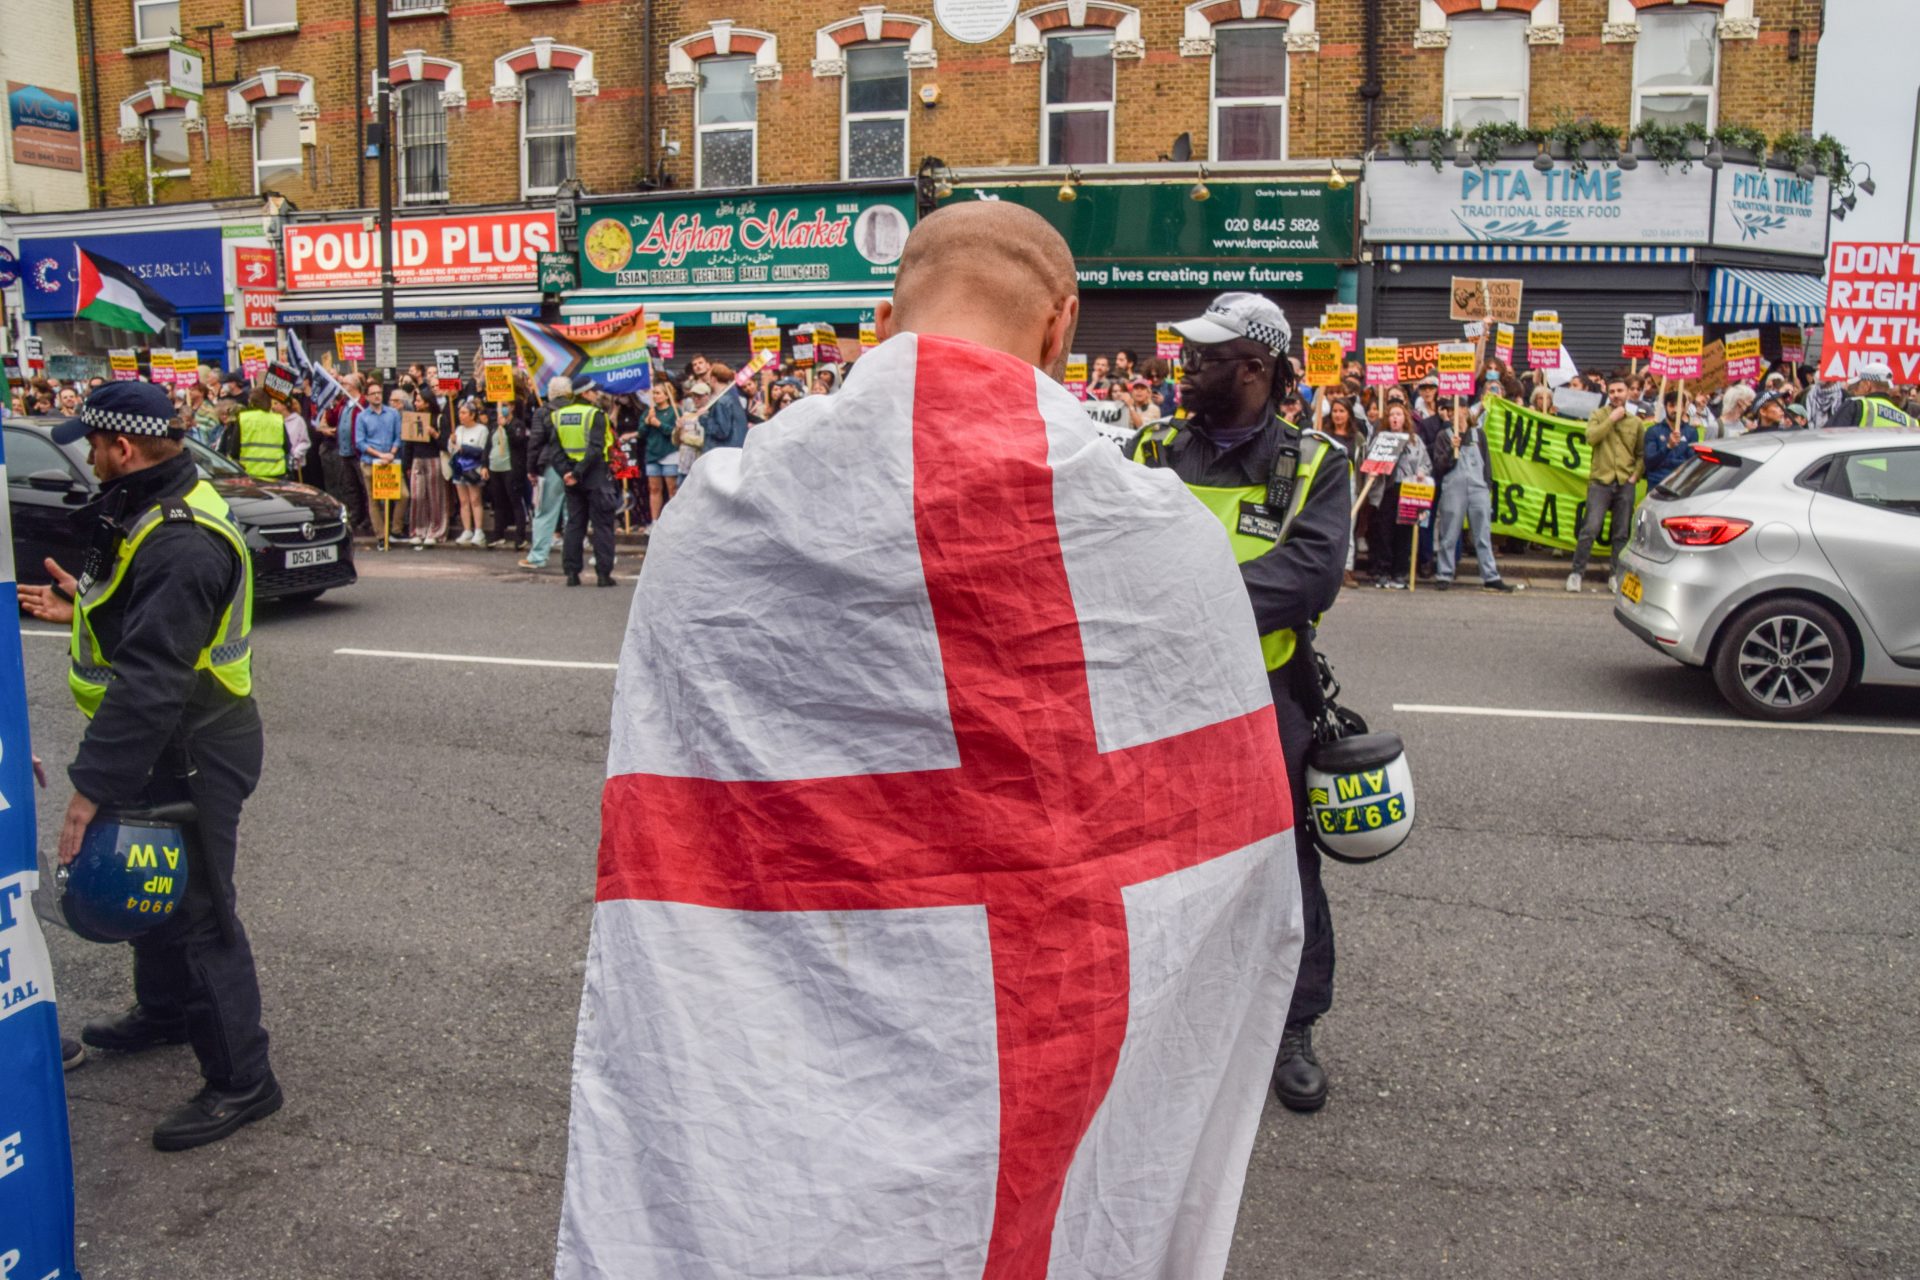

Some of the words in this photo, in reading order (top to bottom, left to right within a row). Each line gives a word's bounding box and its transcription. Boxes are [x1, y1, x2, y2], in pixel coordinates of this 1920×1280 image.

[1461, 169, 1531, 200] PITA
[1542, 169, 1622, 201] TIME
[1734, 172, 1770, 200] PITA
[1774, 178, 1813, 206] TIME
[1461, 205, 1541, 217] TRADITIONAL
[1545, 205, 1584, 217] GREEK
[1588, 205, 1621, 217] FOOD
[1733, 200, 1772, 213] TRADITIONAL
[1775, 205, 1794, 216] GREEK
[1795, 208, 1812, 218] FOOD
[1225, 219, 1249, 231] 020
[1253, 219, 1286, 231] 8445
[1289, 219, 1320, 231] 5826
[291, 229, 428, 271] POUND
[441, 222, 551, 265] PLUS
[636, 212, 733, 267] Afghan
[739, 207, 852, 250] Market
[1213, 235, 1319, 251] www.terapia.co.uk
[617, 270, 648, 285] ASIAN
[650, 269, 688, 284] GROCERIES
[692, 268, 735, 283] VEGETABLES
[739, 266, 768, 281] BAKERY
[802, 264, 829, 279] CARDS
[1076, 269, 1108, 284] oung
[1112, 267, 1144, 282] lives
[1147, 267, 1209, 285] creating
[1213, 269, 1244, 282] new
[1249, 266, 1303, 282] futures
[1831, 280, 1920, 310] RIGH
[566, 313, 639, 337] Haringey
[711, 312, 747, 324] BAKERY
[592, 347, 649, 367] Education
[1440, 353, 1472, 362] Refugees
[607, 367, 641, 382] Union
[1440, 373, 1456, 381] Stop
[1458, 373, 1470, 381] the
[1451, 381, 1470, 391] right
[1878, 404, 1906, 425] POLICE
[1503, 411, 1554, 465] WE
[1562, 431, 1587, 469] S
[1536, 493, 1559, 537] A
[292, 551, 314, 564] DS21
[316, 549, 332, 561] BNL
[1337, 768, 1384, 801] AW
[1320, 798, 1402, 832] 3973
[127, 844, 180, 870] AW
[144, 876, 173, 894] MP
[127, 897, 174, 914] 9904
